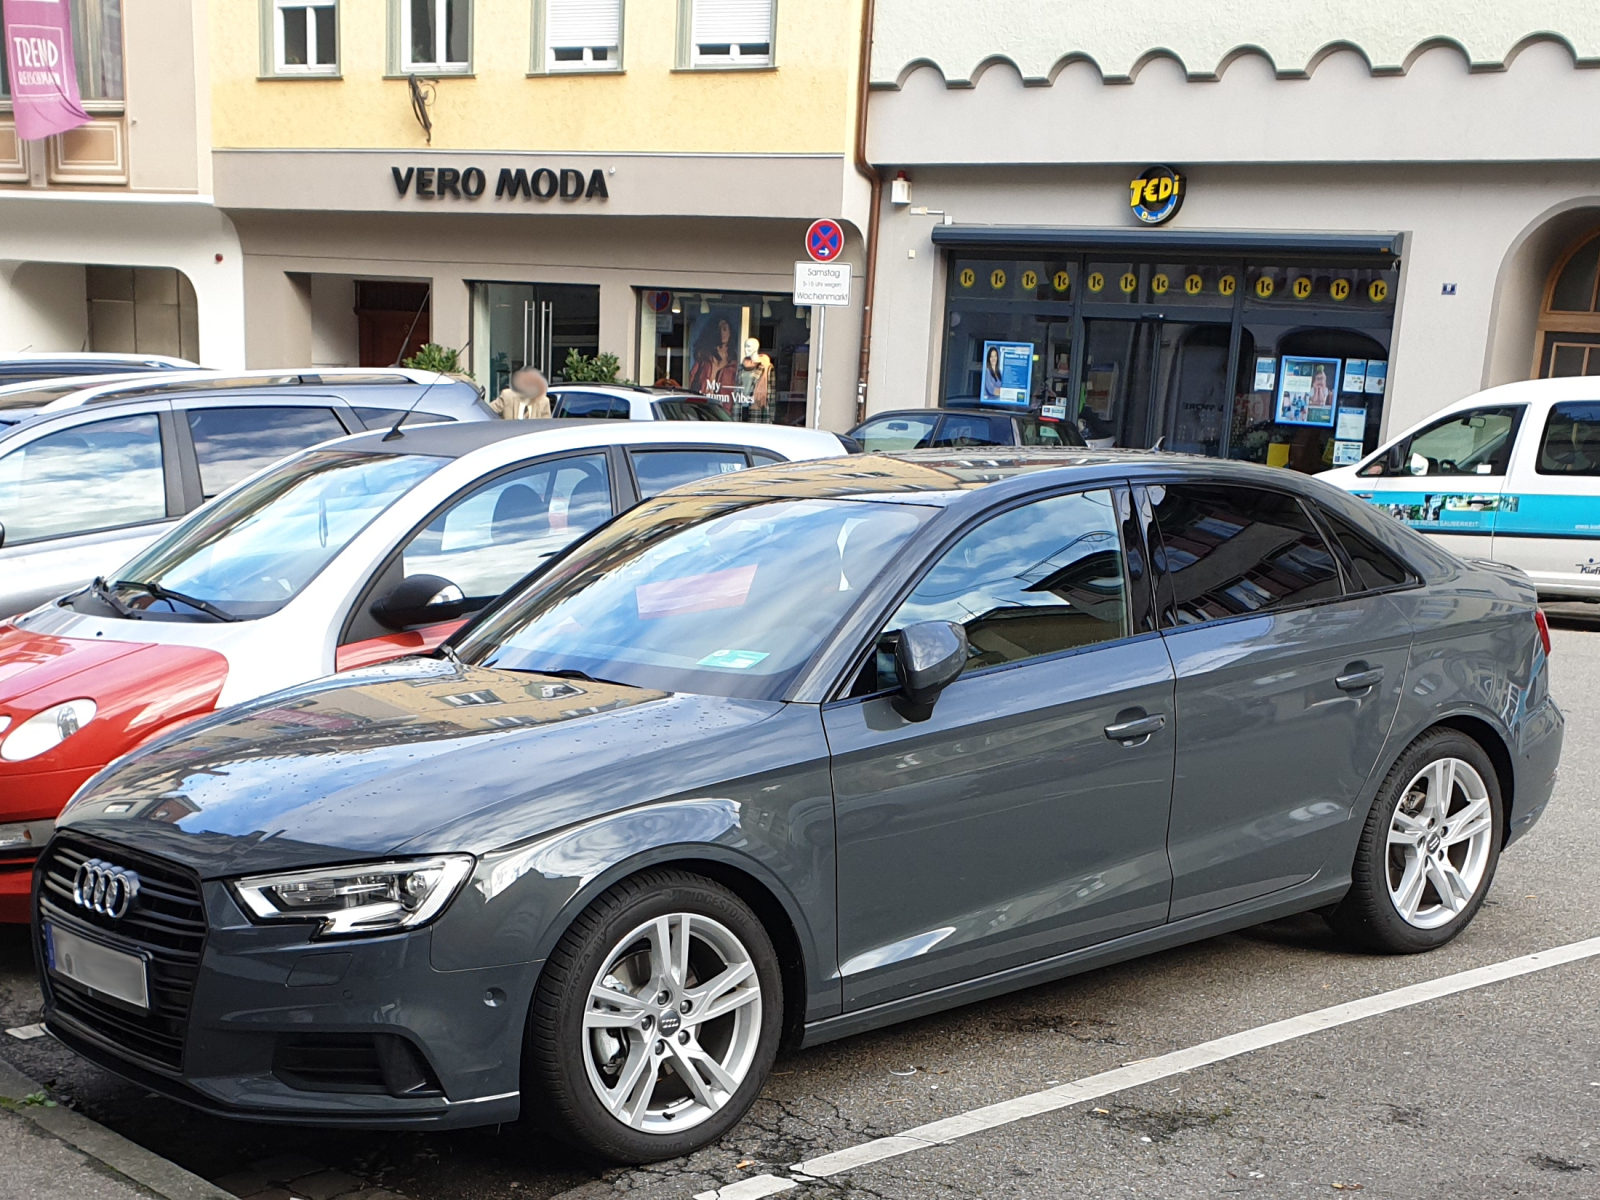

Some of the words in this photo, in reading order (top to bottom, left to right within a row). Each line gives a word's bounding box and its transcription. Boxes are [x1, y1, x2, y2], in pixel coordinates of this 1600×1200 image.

[13, 36, 59, 68] TREND
[391, 166, 487, 197] VERO
[495, 167, 609, 198] MODA
[807, 268, 841, 279] Samstag
[796, 291, 848, 301] Wochenmarkt
[706, 379, 722, 393] My
[731, 391, 755, 404] Vibes
